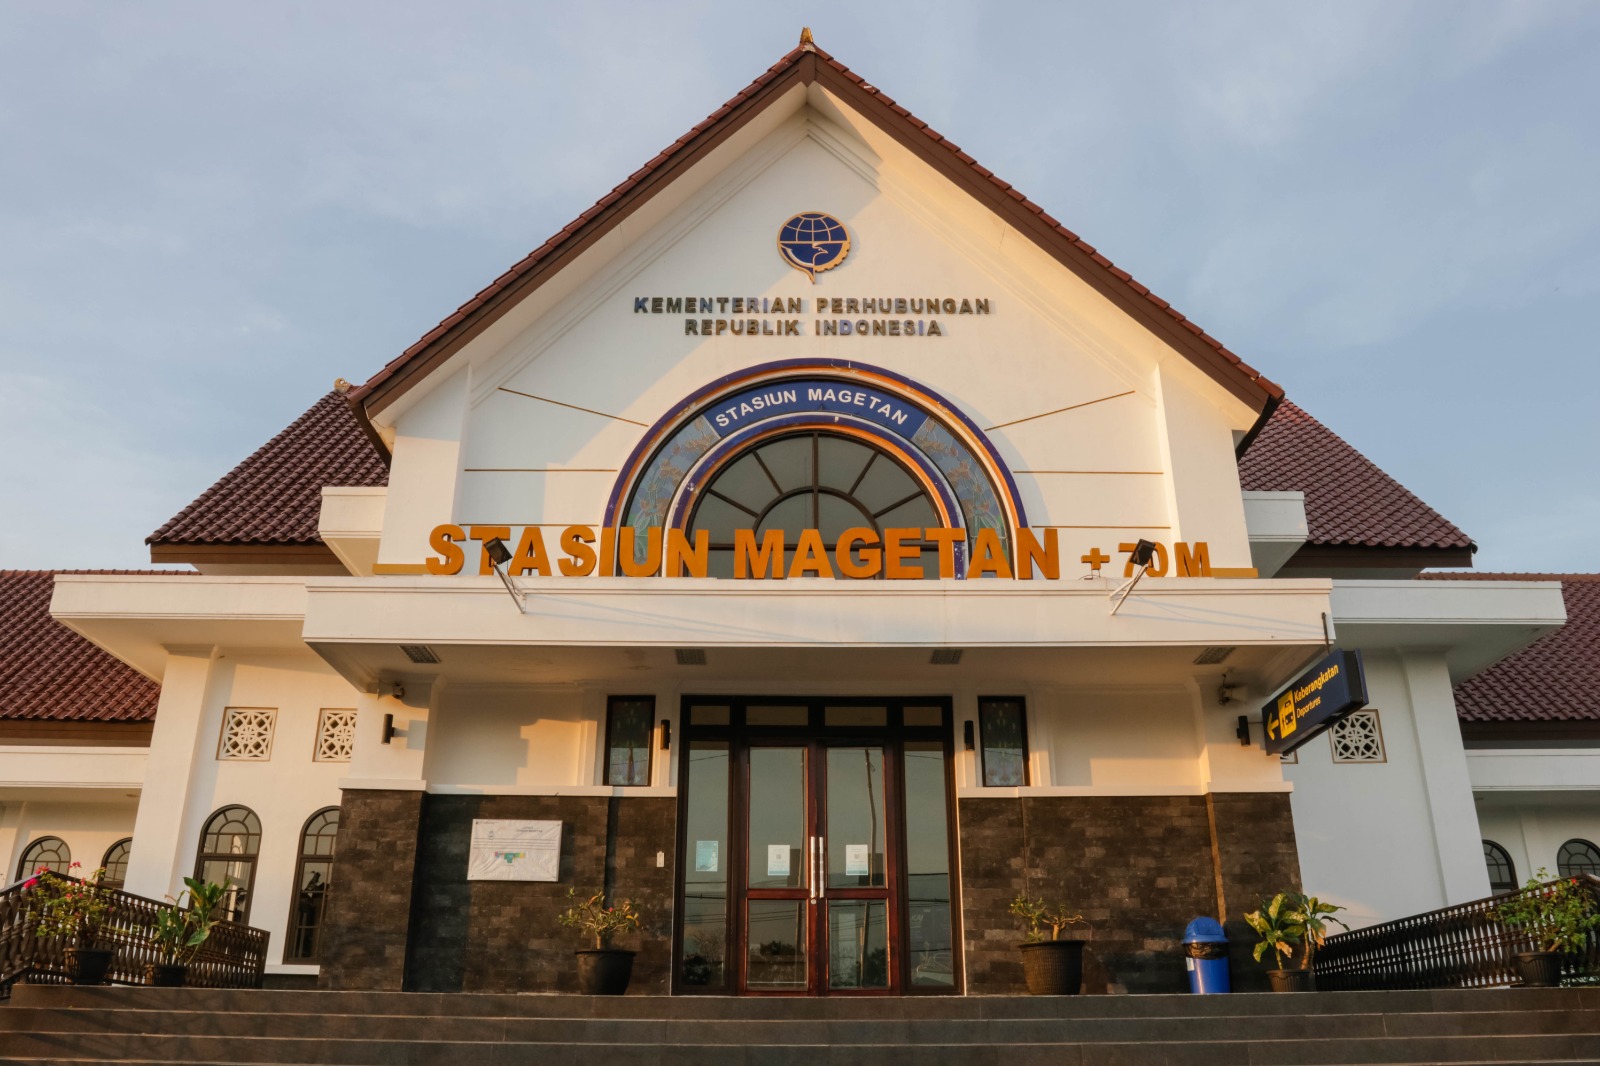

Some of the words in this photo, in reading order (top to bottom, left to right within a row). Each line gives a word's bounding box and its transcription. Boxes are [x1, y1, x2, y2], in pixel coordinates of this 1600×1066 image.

[634, 297, 802, 314] KEMENTERIAN
[816, 298, 990, 315] PERHUBUNGAN
[685, 319, 799, 336] REPUBLIK
[815, 319, 942, 336] INDONESIA
[715, 389, 797, 427] STASIUN
[808, 388, 908, 425] MAGETAN
[425, 524, 709, 578] STASIUN
[733, 527, 1060, 580] MAGETAN
[1294, 664, 1339, 703] Keberangkatan
[1296, 696, 1321, 718] Departures
